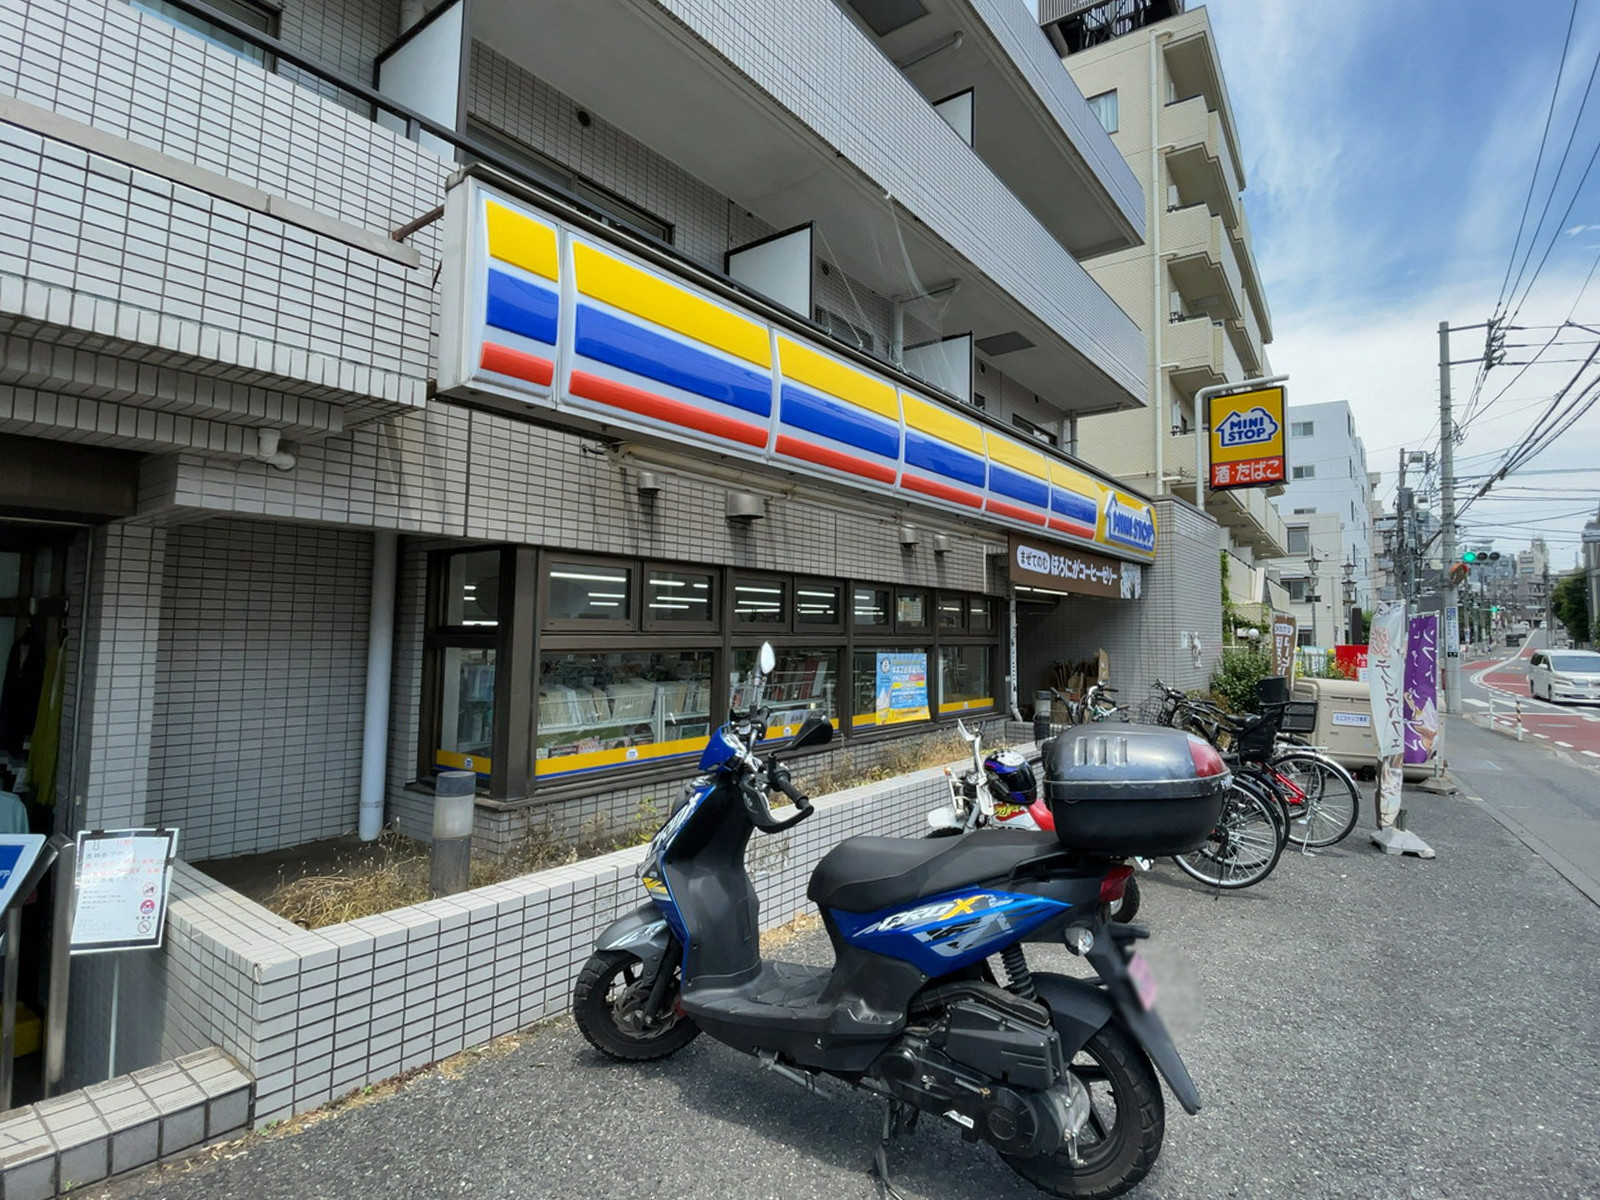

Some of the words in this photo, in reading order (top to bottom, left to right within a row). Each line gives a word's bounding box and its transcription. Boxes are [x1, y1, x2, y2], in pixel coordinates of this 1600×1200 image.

[1229, 416, 1264, 431] MINI
[1228, 427, 1266, 442] STOP
[1051, 554, 1118, 586] ほろにがコーヒーゼリー
